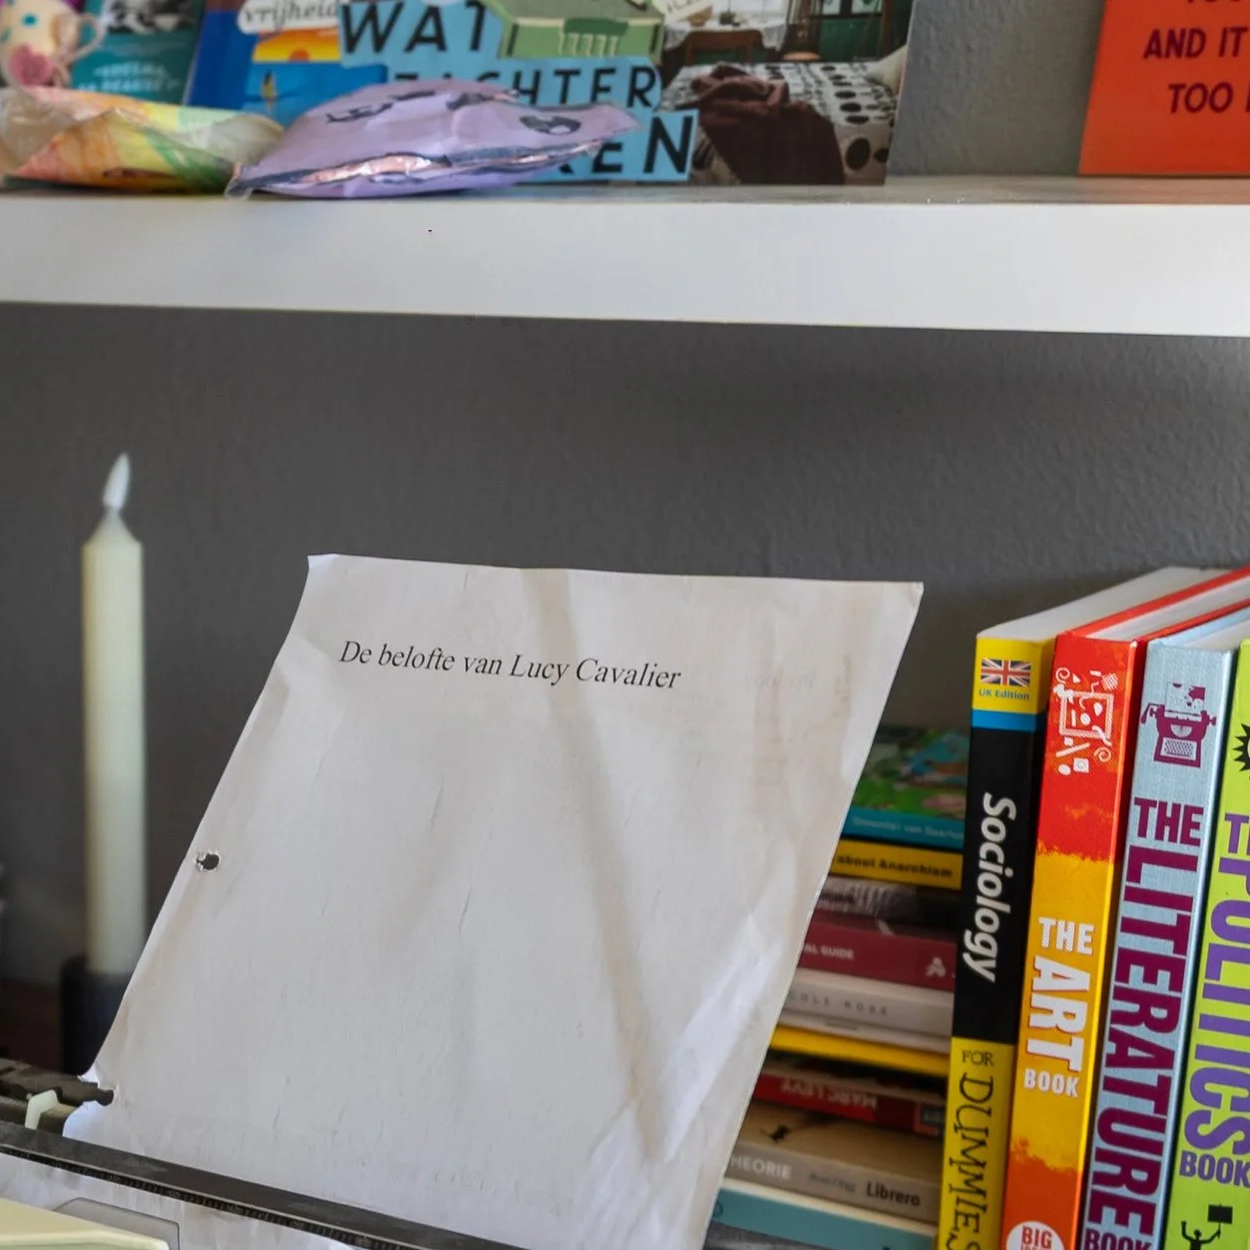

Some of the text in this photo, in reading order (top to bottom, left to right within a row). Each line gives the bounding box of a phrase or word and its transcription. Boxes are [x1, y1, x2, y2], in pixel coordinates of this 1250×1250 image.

[341, 0, 488, 53] WAT
[1143, 26, 1249, 59] AND IT
[1168, 82, 1234, 114] TOO
[338, 640, 682, 689] De belofte van Lucy Cavalier
[978, 688, 1030, 702] UK Edition
[1134, 797, 1204, 847] THE
[837, 855, 953, 878] about Anarchism
[962, 791, 1017, 984] Sociology
[821, 945, 855, 960] GUIDE
[1039, 916, 1095, 956] THE
[1027, 955, 1092, 1073] ART
[1087, 845, 1199, 1237] LITERATURE
[962, 1050, 994, 1067] FOR
[1024, 1068, 1080, 1098] BOOK
[1180, 1150, 1250, 1188] BOOK
[866, 1181, 921, 1207] Librero
[1021, 1225, 1052, 1249] BIG
